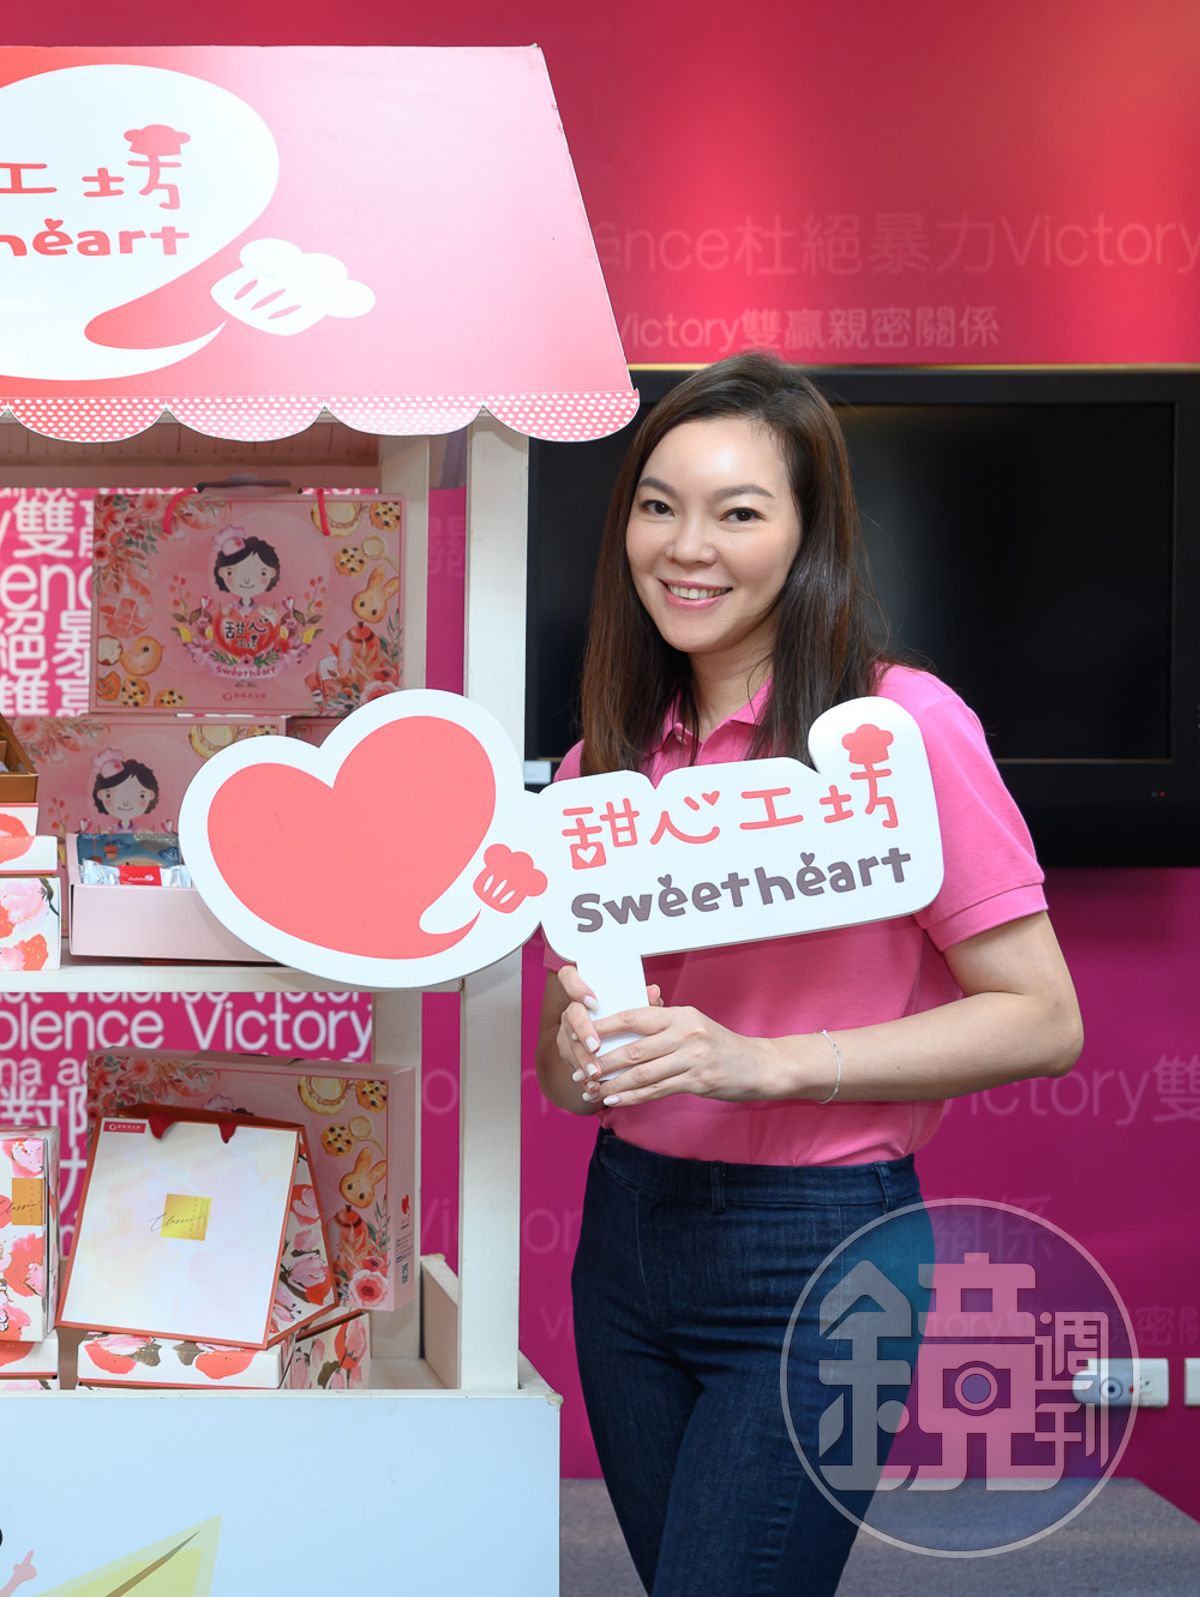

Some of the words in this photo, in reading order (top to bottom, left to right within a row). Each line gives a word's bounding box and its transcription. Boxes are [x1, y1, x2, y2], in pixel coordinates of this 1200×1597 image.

[561, 723, 900, 871] 甜心工坊
[570, 846, 912, 933] Sweetheart
